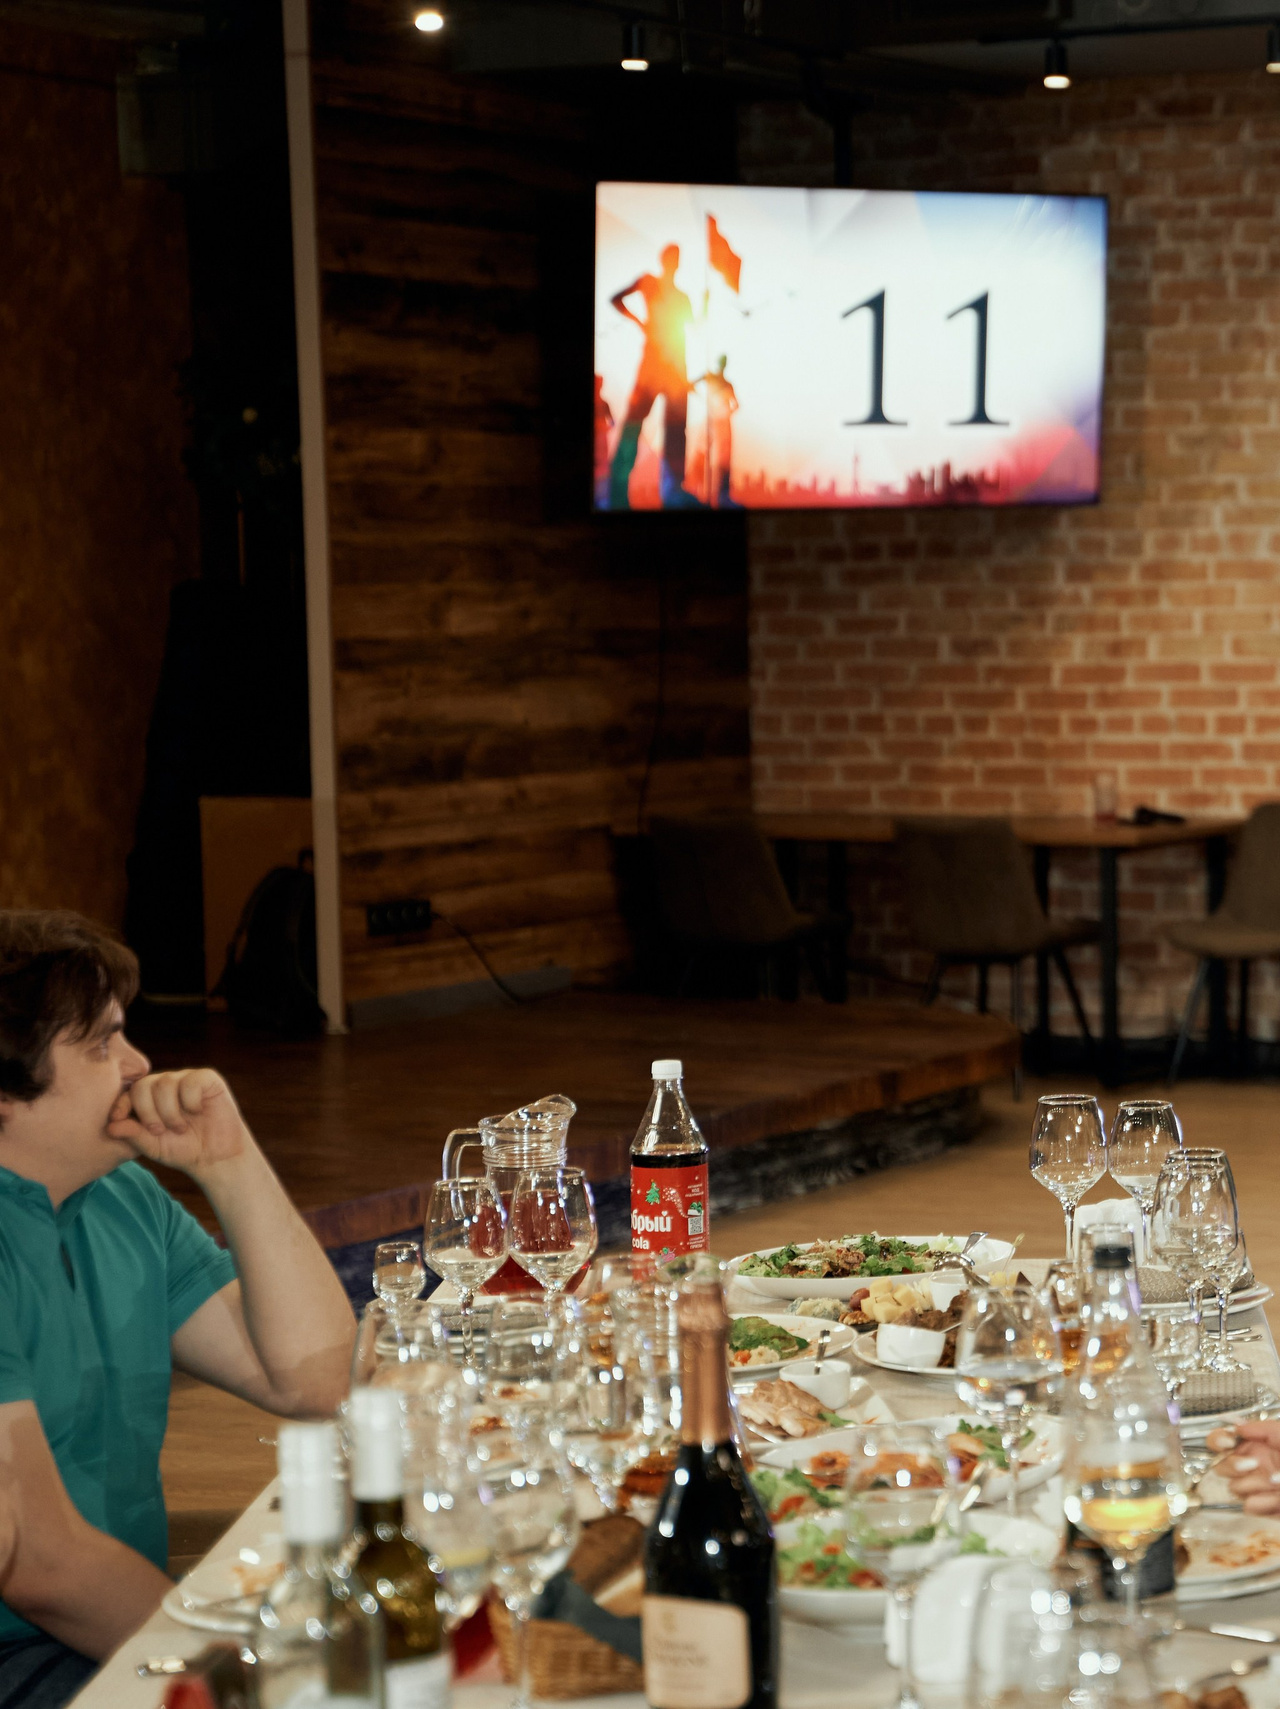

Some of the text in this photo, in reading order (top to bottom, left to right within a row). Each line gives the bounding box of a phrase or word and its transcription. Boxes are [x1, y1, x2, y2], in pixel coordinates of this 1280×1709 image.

[841, 288, 1010, 427] 11
[631, 1209, 671, 1234] брый
[632, 1237, 650, 1250] cola
